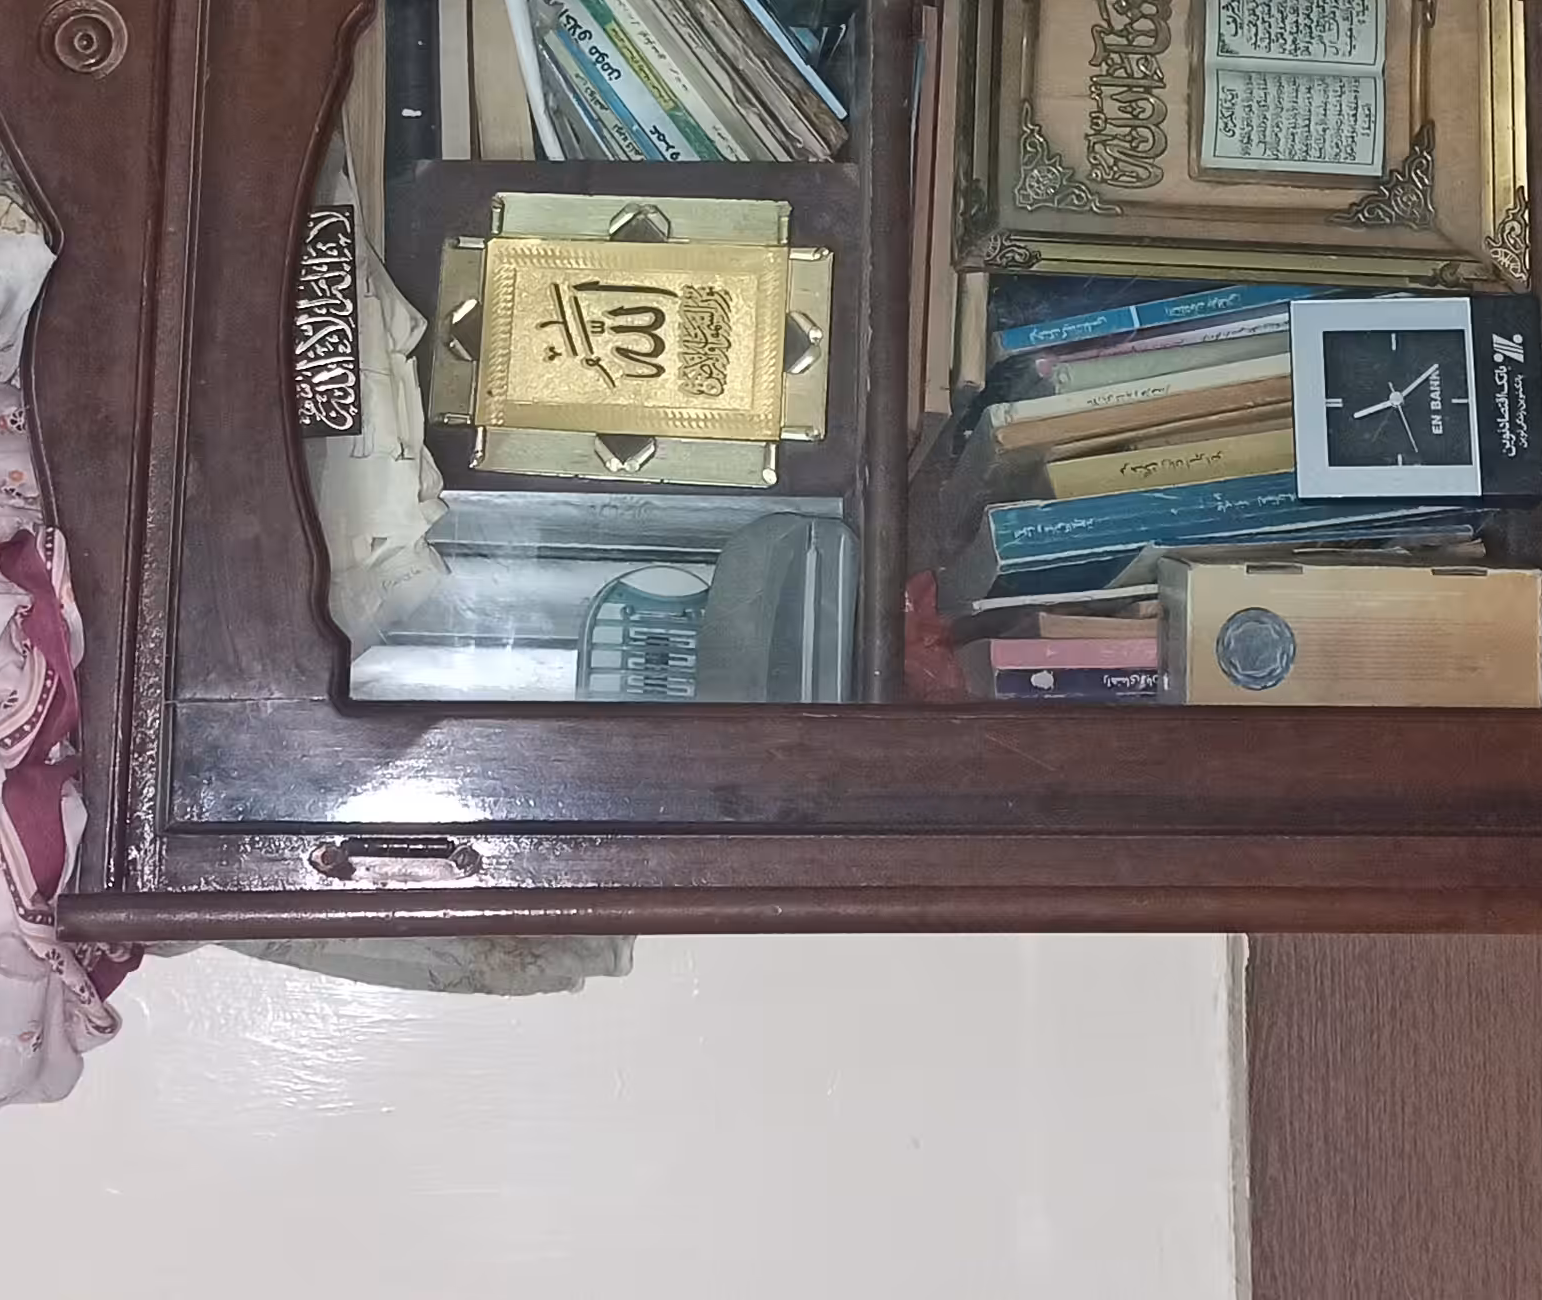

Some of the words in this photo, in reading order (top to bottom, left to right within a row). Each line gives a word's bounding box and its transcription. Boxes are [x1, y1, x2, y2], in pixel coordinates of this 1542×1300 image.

[558, 8, 595, 44] اخلاق
[536, 280, 678, 389] الله
[1493, 364, 1513, 393] بانک
[1431, 414, 1444, 435] EN
